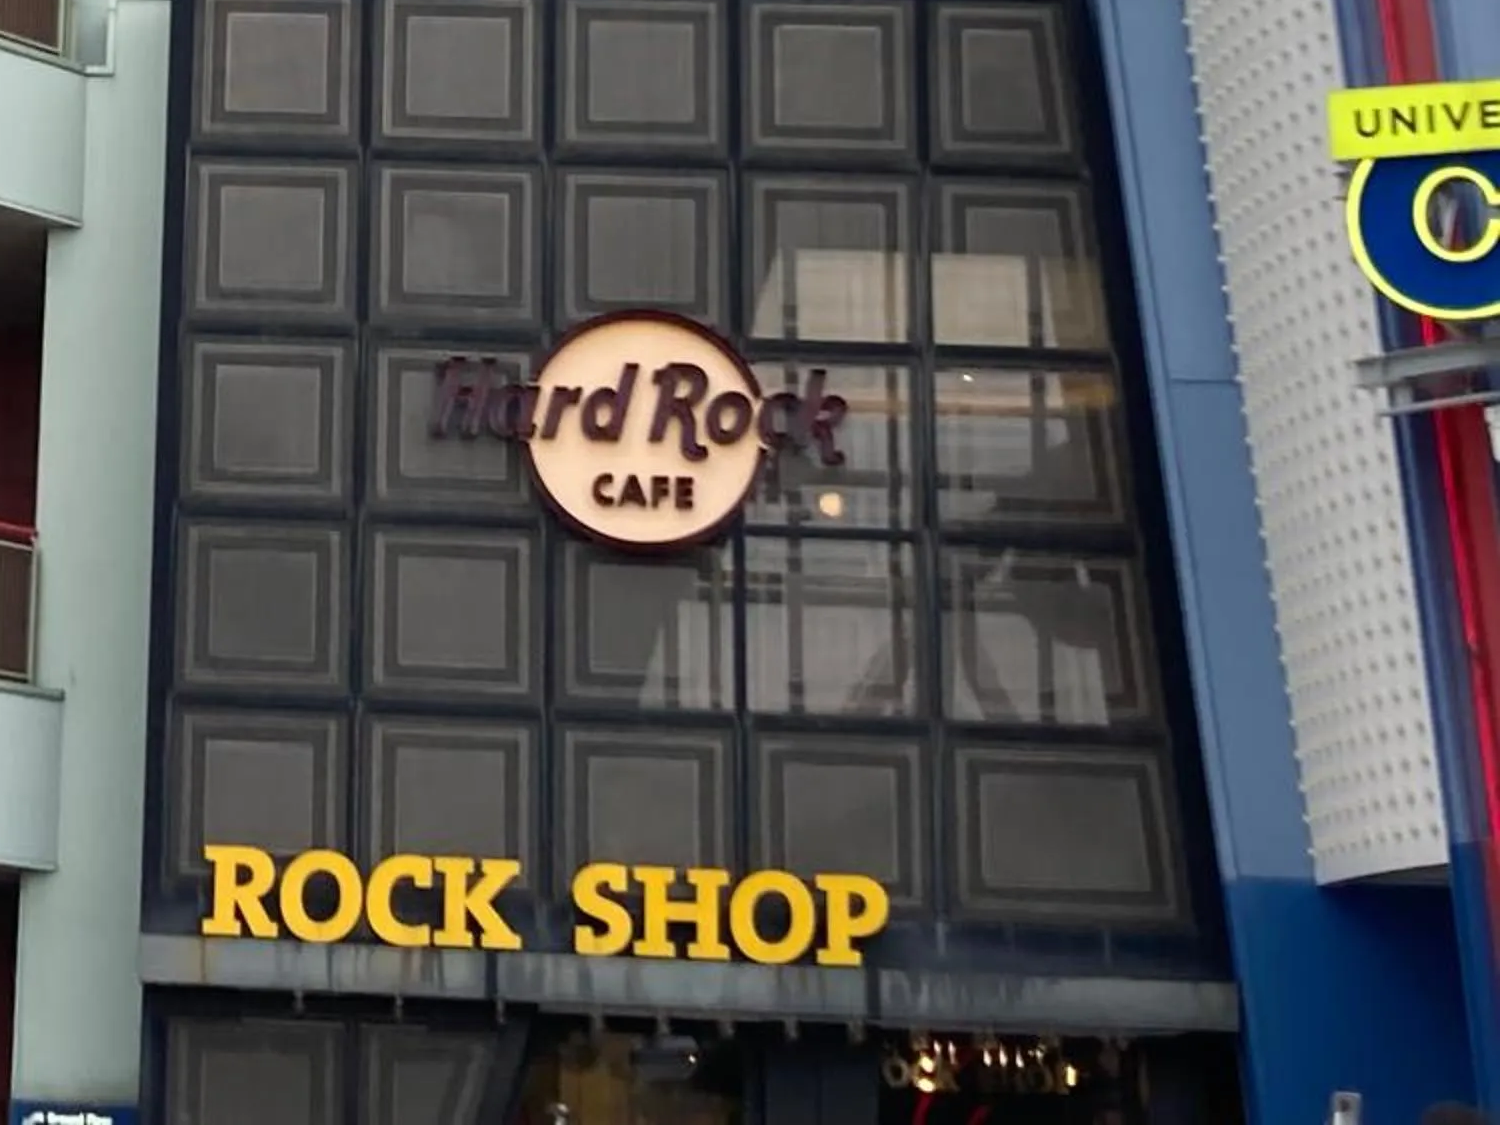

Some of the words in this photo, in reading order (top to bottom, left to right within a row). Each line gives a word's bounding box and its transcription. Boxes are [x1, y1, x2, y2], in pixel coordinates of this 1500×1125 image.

[432, 356, 639, 443] Hard
[648, 361, 849, 466] Rock
[591, 473, 695, 511] CAFE
[202, 844, 522, 950] ROCK
[572, 863, 890, 966] SHOP
